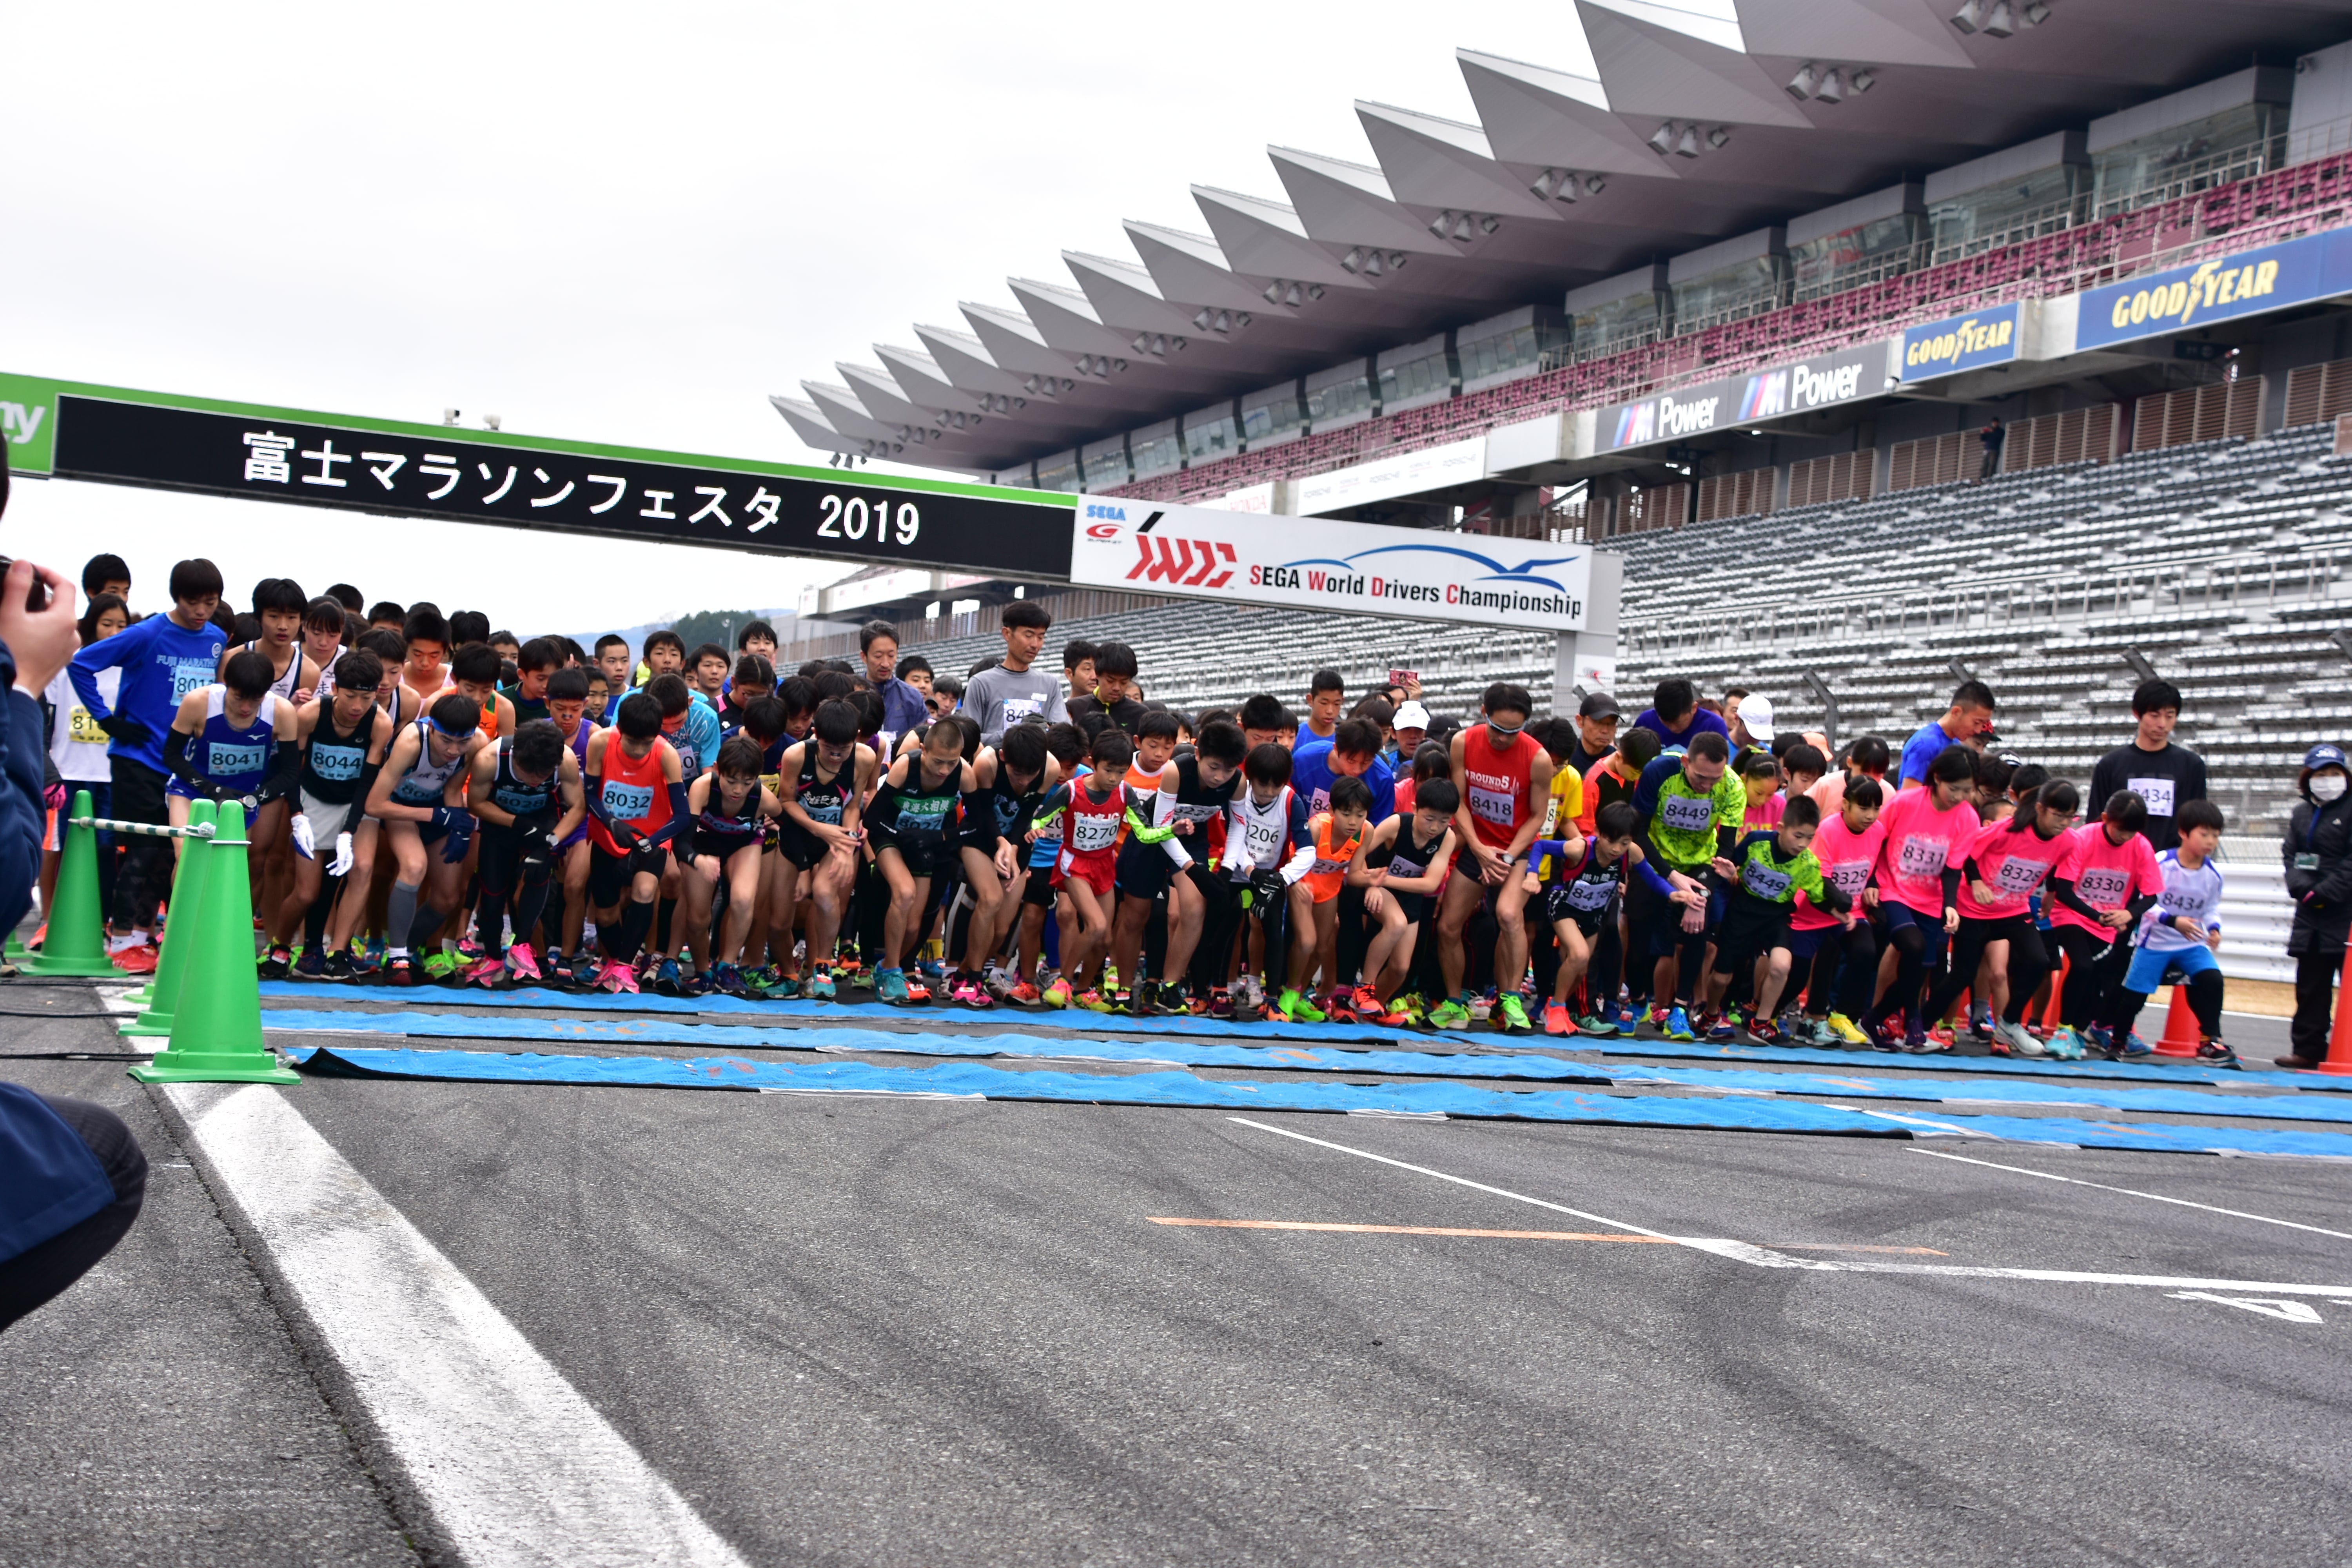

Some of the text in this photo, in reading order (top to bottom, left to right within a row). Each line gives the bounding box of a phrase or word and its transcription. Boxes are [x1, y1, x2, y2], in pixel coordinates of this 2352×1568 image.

[2112, 259, 2278, 328] GOODYEAR
[1907, 319, 2013, 366] GOODYEAR
[1791, 362, 1862, 409] Power
[1658, 396, 1719, 438] Power
[243, 430, 920, 545] 富士マラソンフェスタ 2019
[1087, 505, 1126, 521] SEGA
[1250, 564, 1582, 619] SEGA World Drivers Championship
[1006, 709, 1033, 723] 84
[212, 753, 260, 766] 8041
[314, 752, 361, 769] 8044
[498, 795, 545, 808] 8028
[604, 791, 650, 809] 8032
[1472, 795, 1512, 816] 8418
[808, 812, 839, 824] 024
[1666, 804, 1710, 820] 8449
[900, 818, 943, 830] 8027
[1076, 824, 1117, 840] 8270
[1903, 844, 1944, 865] 8331
[1746, 865, 1786, 891] 8449
[1831, 868, 1868, 885] 8329
[2082, 877, 2125, 893] 8330
[2162, 892, 2205, 911] 8434
